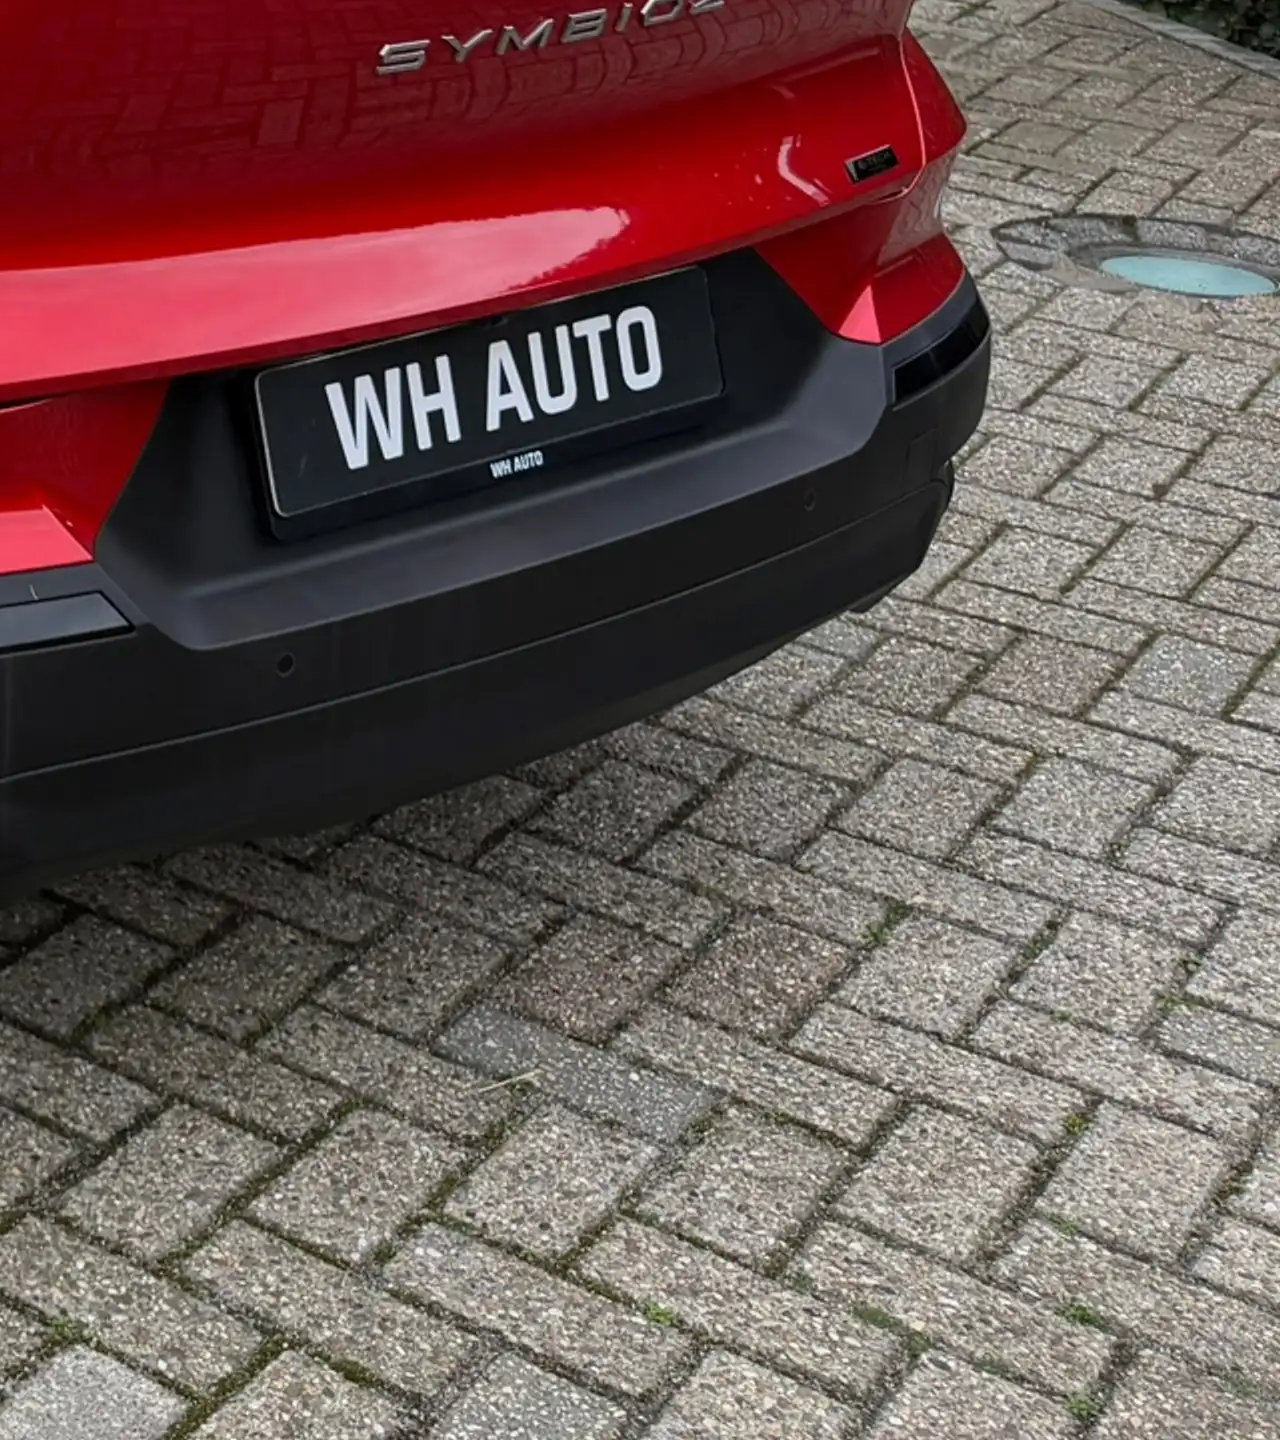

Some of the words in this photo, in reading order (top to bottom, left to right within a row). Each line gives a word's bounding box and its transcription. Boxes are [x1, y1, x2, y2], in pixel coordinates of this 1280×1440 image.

[324, 354, 462, 470] WH
[486, 305, 663, 432] AUTO
[489, 458, 513, 479] WH
[514, 450, 544, 472] AUTO
